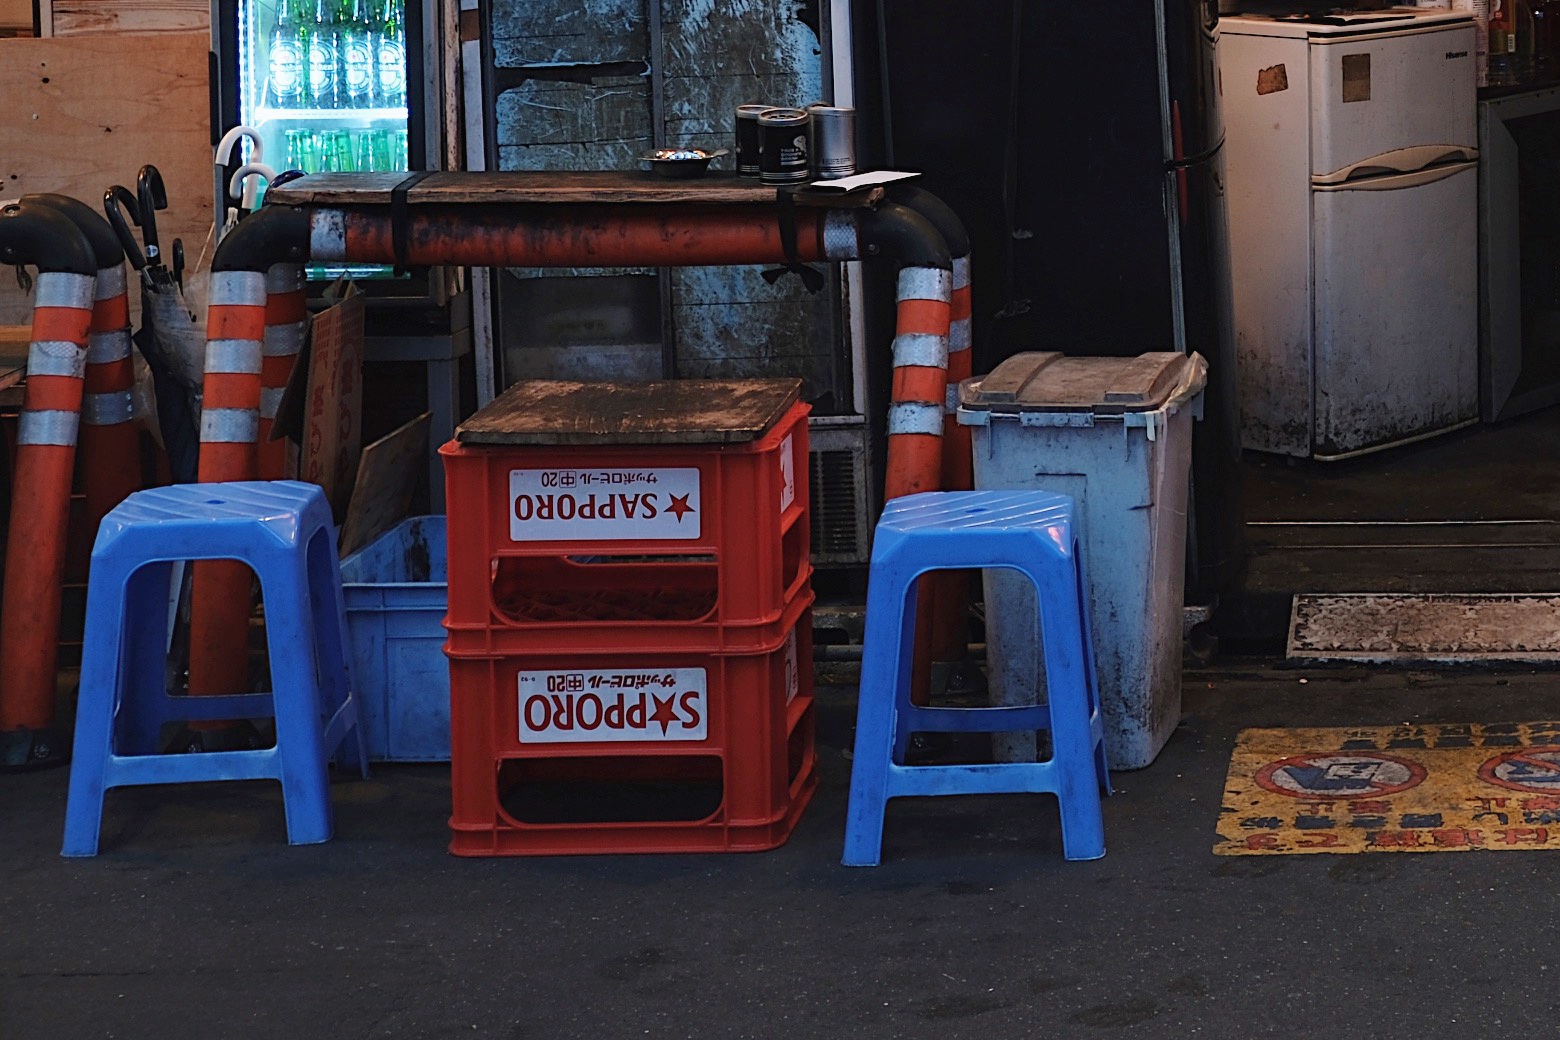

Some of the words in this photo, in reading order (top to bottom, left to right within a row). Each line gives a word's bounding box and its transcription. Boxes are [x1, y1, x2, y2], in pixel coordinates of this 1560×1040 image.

[1446, 51, 1468, 59] Hisense
[580, 472, 658, 485] サッポロビール
[514, 493, 658, 520] SAPPORO
[588, 674, 676, 689] サッポロビール
